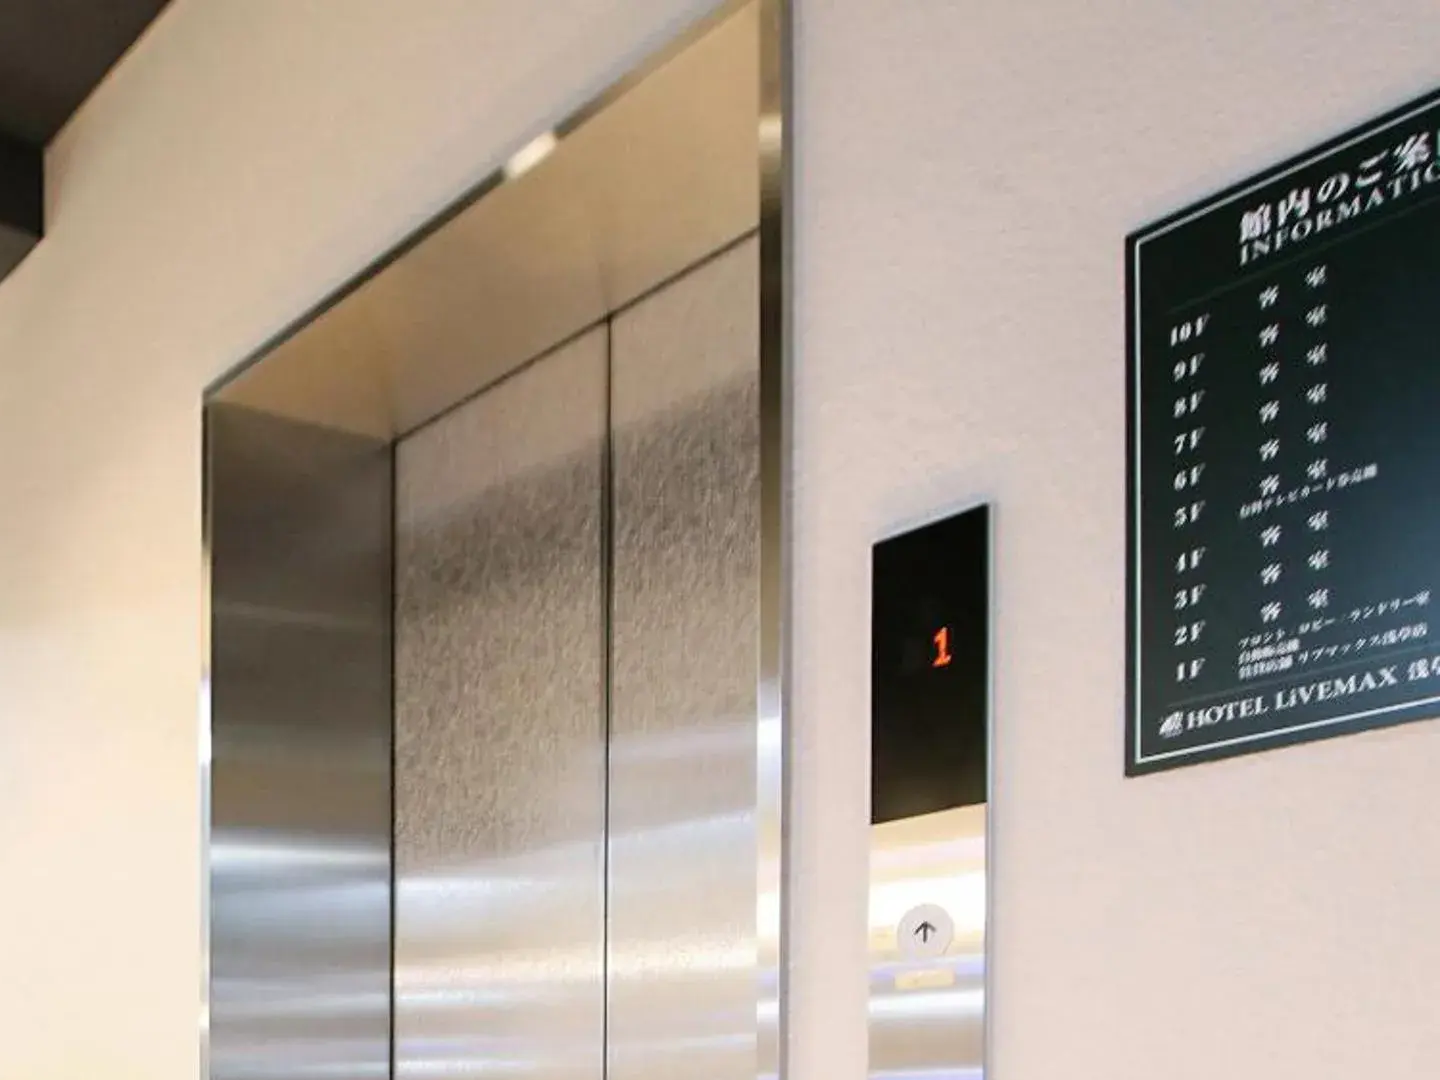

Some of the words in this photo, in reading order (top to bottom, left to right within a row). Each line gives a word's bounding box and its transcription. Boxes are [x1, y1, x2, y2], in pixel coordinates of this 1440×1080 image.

[1240, 129, 1440, 244] 館内のご案
[1174, 427, 1206, 455] 7F
[933, 627, 953, 667] 1
[1174, 620, 1206, 646] 2F
[1186, 696, 1269, 731] HOTEL
